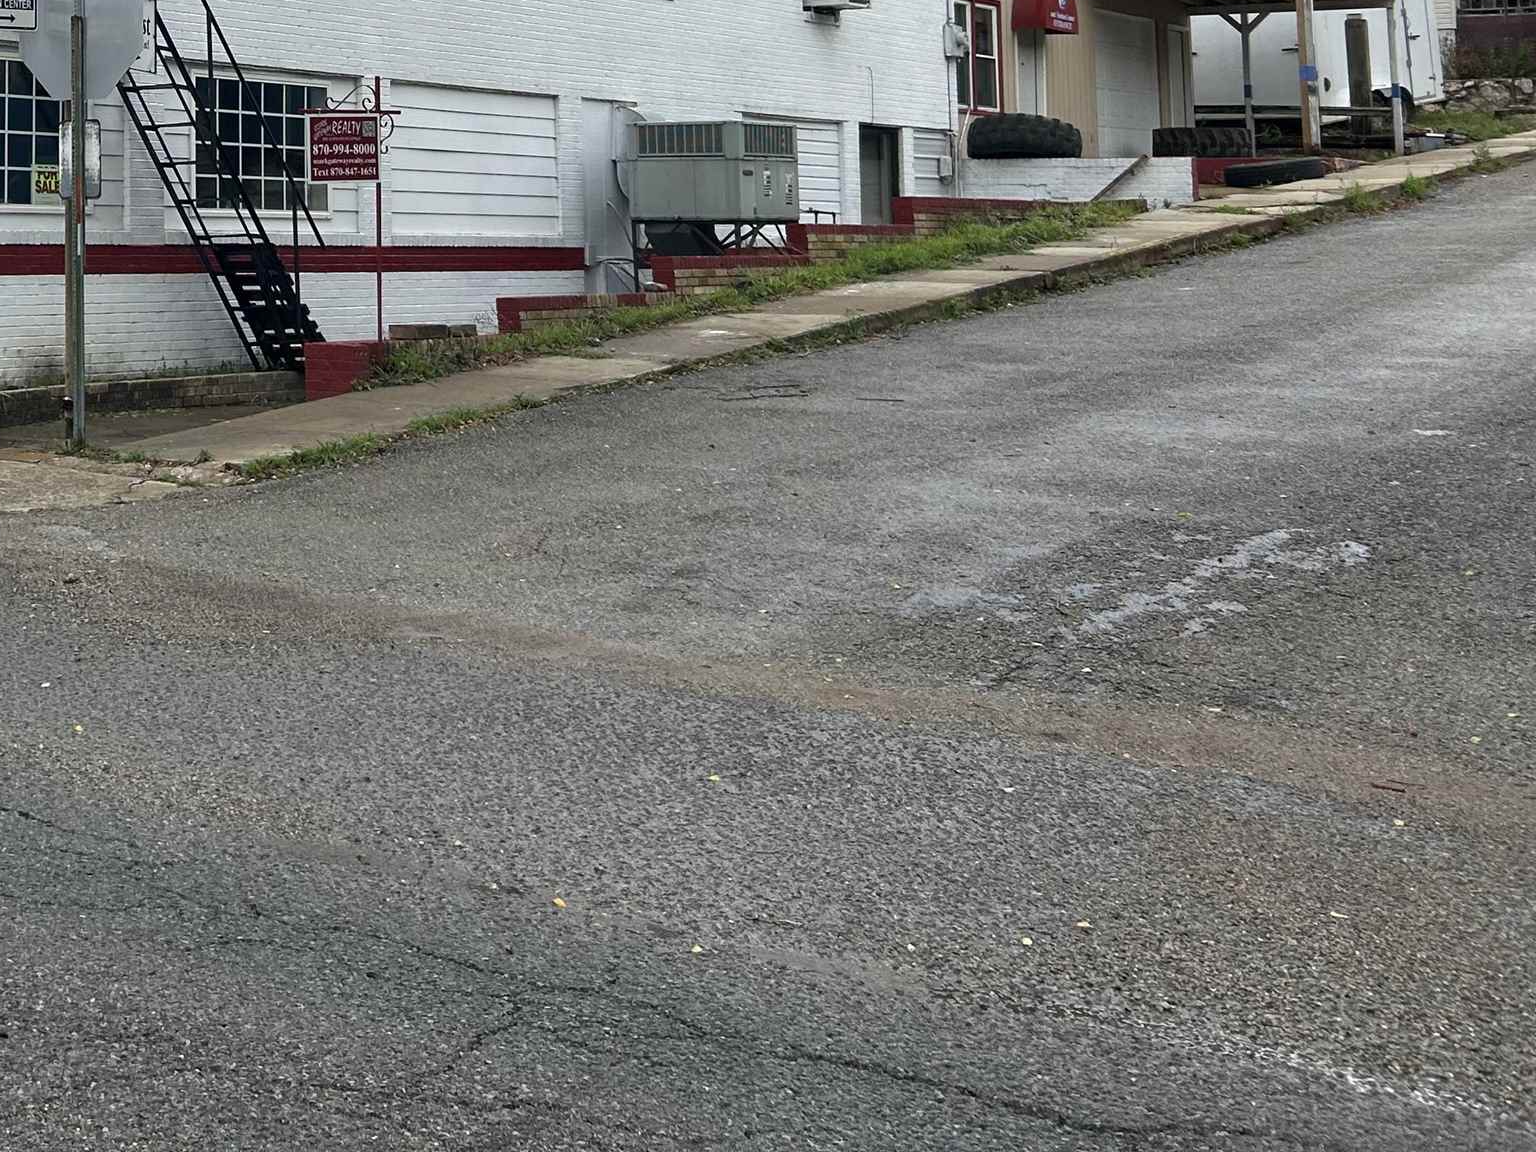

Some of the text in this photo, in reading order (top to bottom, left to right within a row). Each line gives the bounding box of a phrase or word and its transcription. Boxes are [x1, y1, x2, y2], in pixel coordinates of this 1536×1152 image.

[332, 120, 362, 136] REALTY
[312, 143, 376, 156] 870-994-8000
[313, 167, 330, 177] Text
[34, 180, 60, 194] SALE
